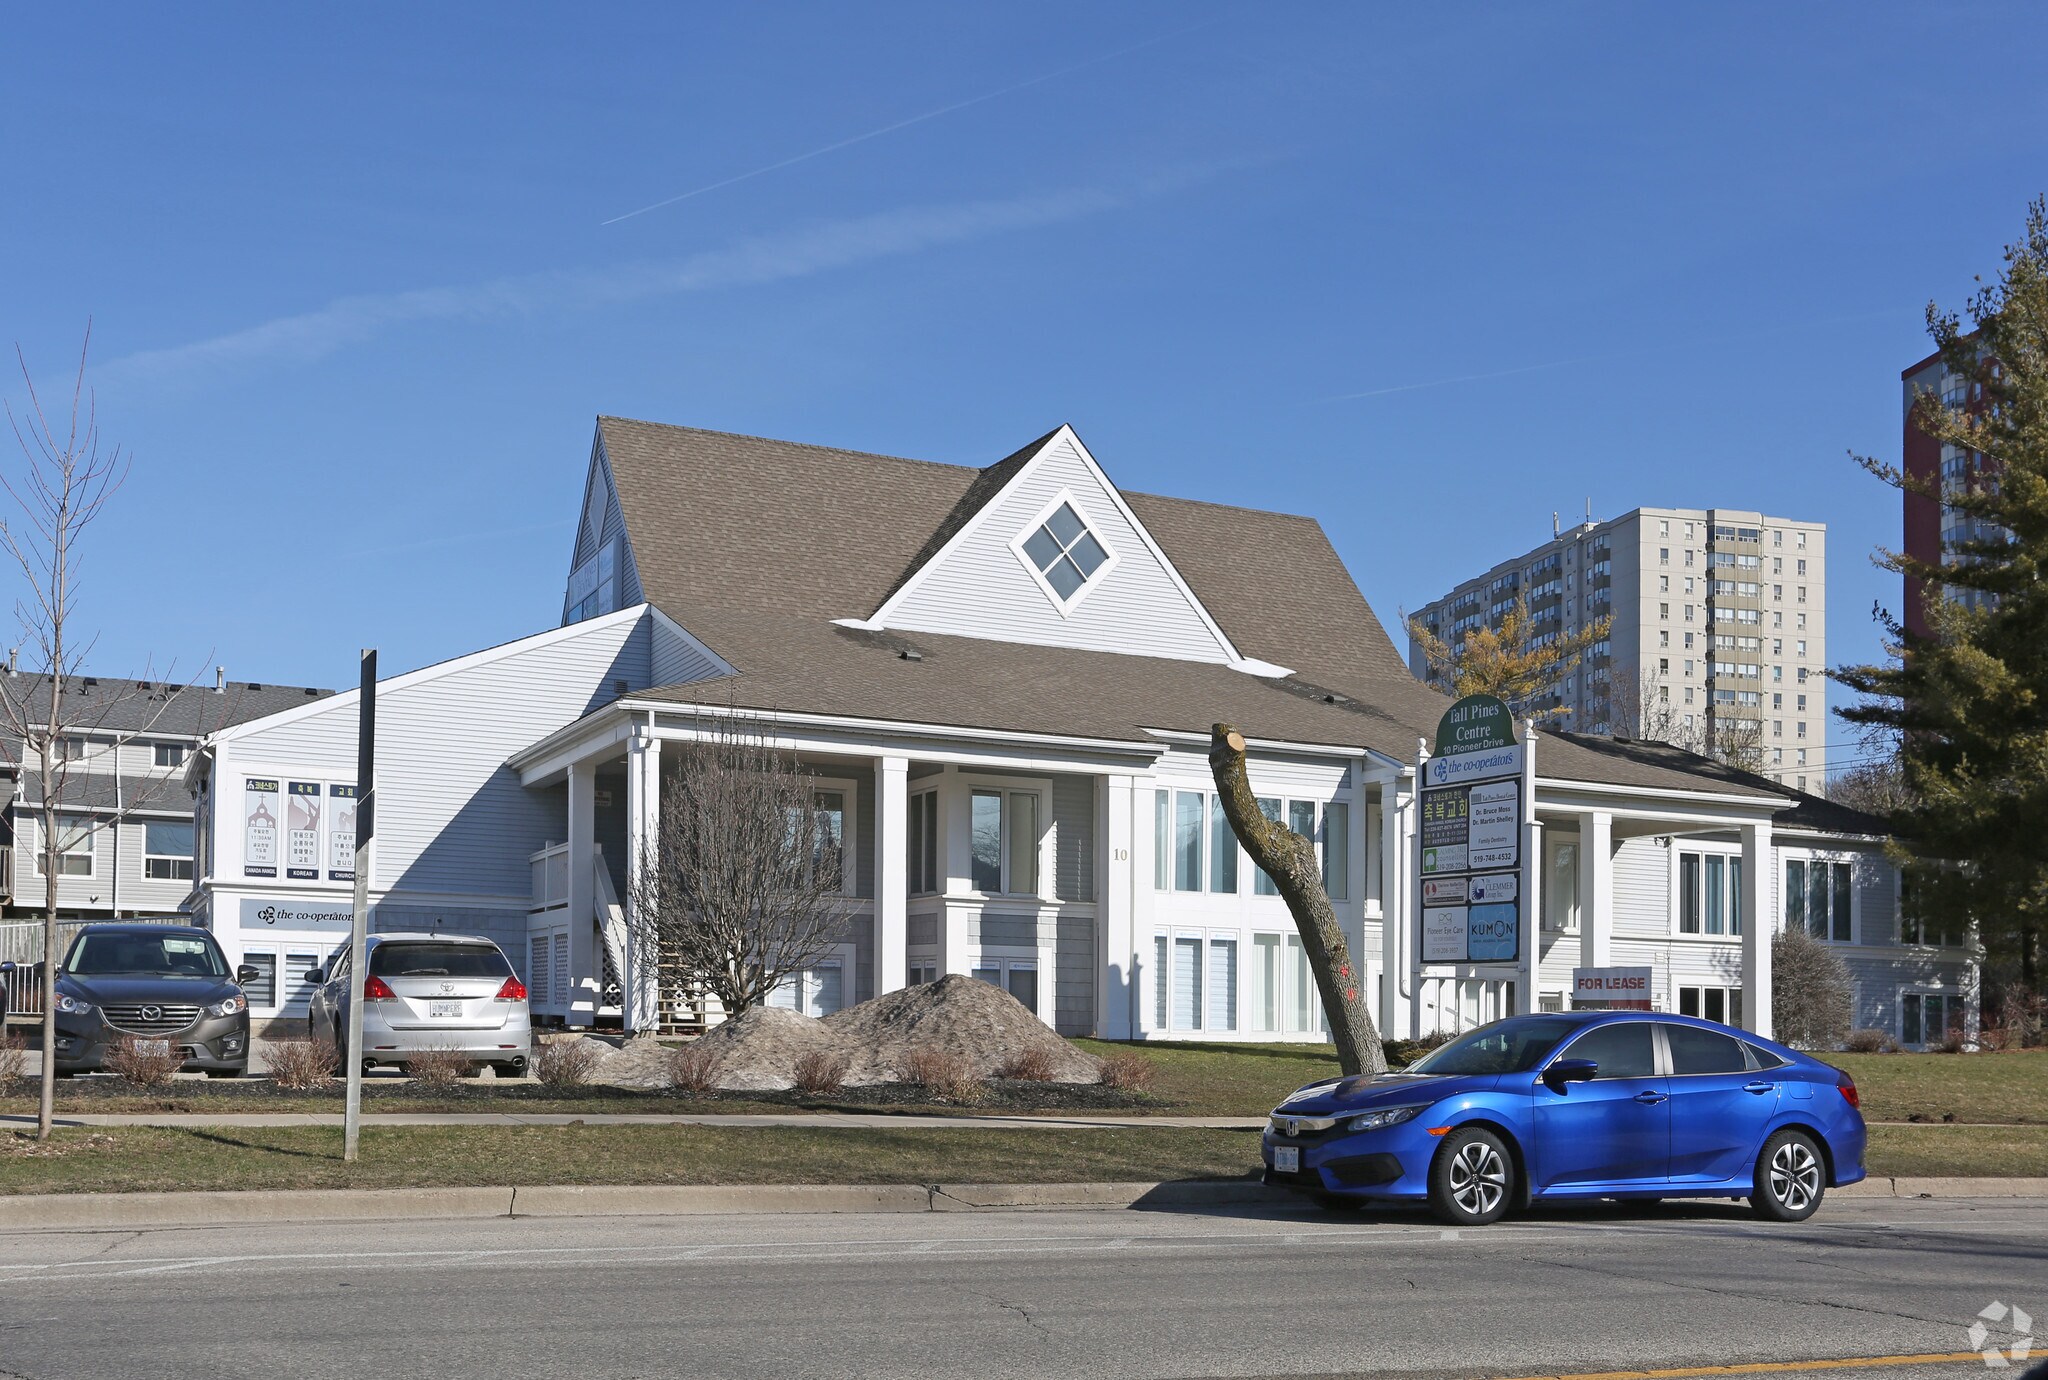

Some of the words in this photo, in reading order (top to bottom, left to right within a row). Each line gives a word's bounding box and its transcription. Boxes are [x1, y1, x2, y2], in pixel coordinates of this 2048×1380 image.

[1450, 707, 1467, 723] Tall
[1471, 704, 1499, 720] Pines
[1456, 725, 1491, 741] Centre
[1443, 746, 1451, 755] 10
[1452, 742, 1482, 753] Pioneer
[1483, 738, 1504, 748] Drive
[1448, 760, 1461, 773] the
[1424, 798, 1468, 821] 축복교회
[1114, 848, 1128, 861] 10
[1473, 853, 1512, 863] 519-748-4532
[277, 909, 294, 919] the
[1427, 927, 1443, 935] Pioneer
[1444, 926, 1452, 935] Eye
[1453, 925, 1463, 934] Care
[1471, 920, 1514, 937] KUMON
[1578, 978, 1603, 990] FOR
[1605, 977, 1645, 990] LEASE
